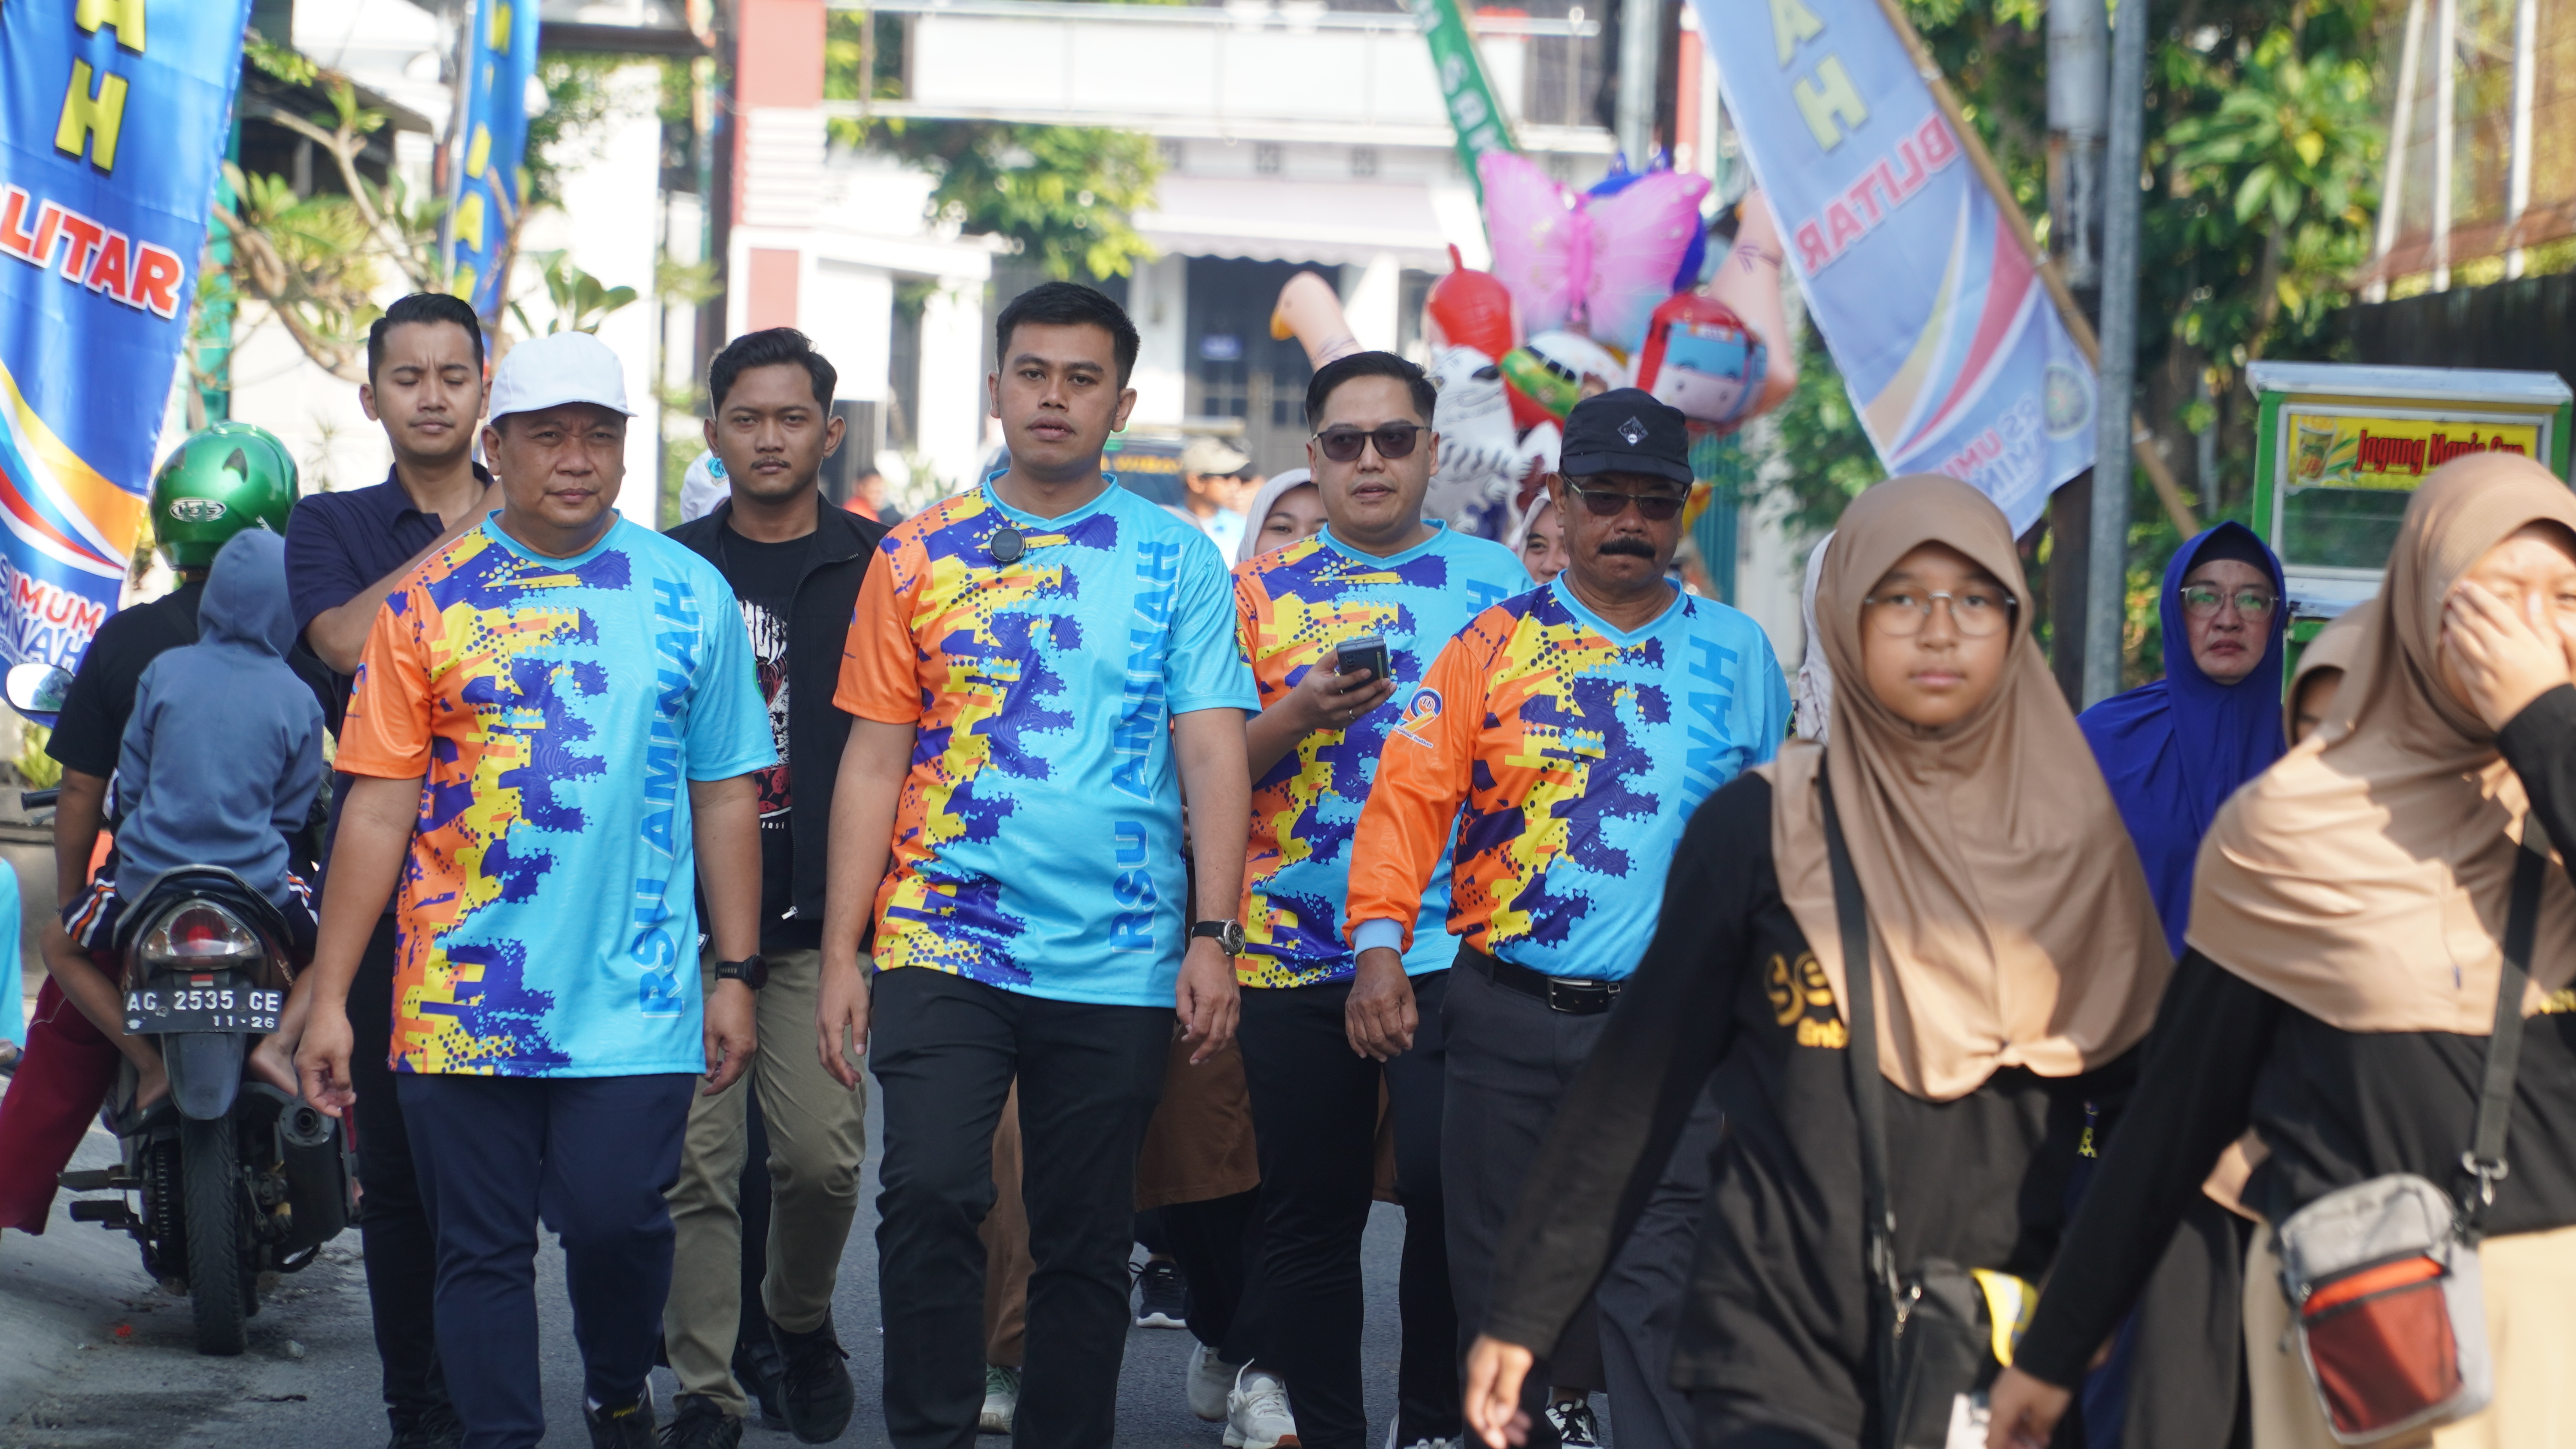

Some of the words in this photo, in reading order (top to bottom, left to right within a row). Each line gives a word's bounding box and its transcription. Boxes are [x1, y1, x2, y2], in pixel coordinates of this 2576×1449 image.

[0, 182, 185, 320] LITAR
[2354, 429, 2426, 476] Jagung
[640, 577, 705, 861] AMINAH
[1111, 541, 1183, 805] AMINAH
[630, 876, 683, 1019] RSU
[1109, 821, 1160, 954] RSU
[126, 992, 157, 1012] AG
[173, 990, 234, 1011] 2535
[249, 992, 279, 1012] GE
